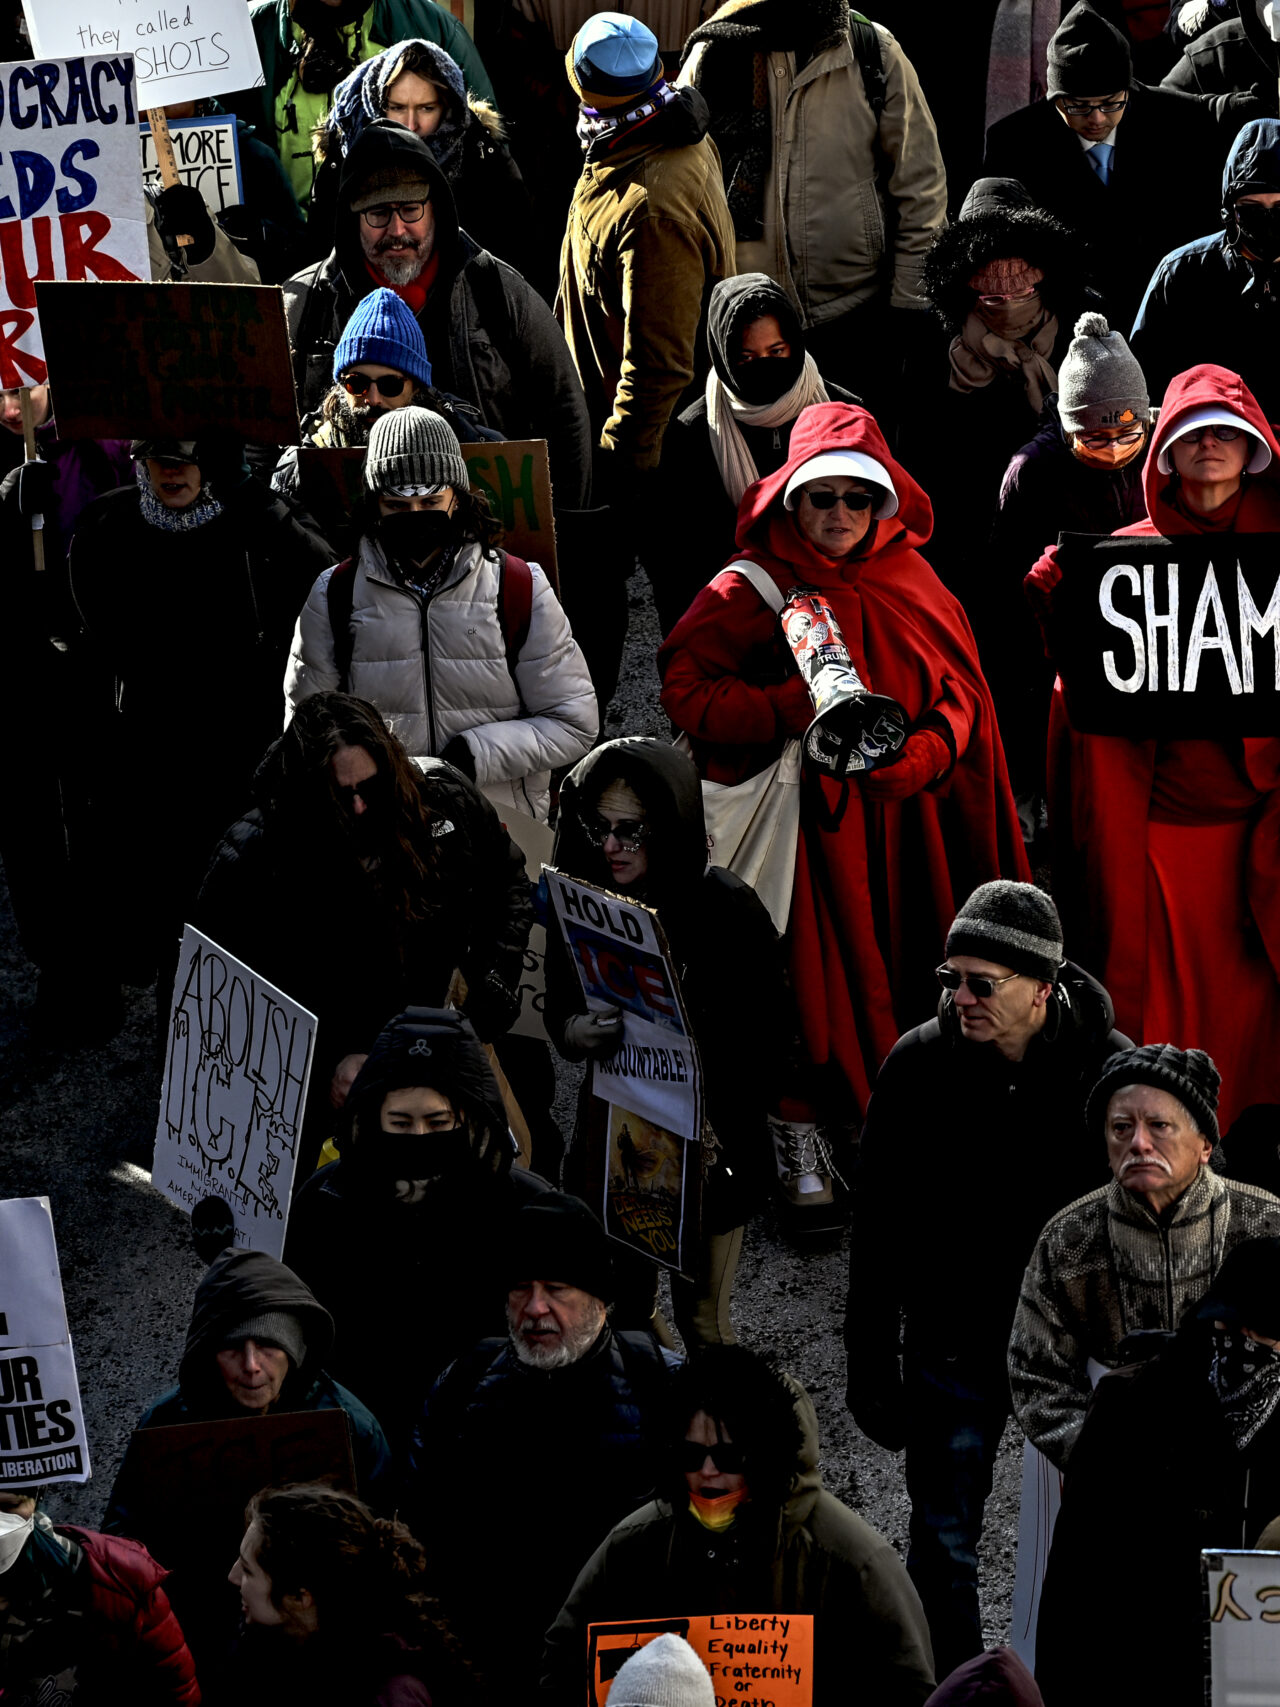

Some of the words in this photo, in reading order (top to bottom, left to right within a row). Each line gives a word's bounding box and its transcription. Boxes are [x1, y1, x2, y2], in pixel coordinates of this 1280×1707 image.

[77, 25, 120, 51] they
[136, 5, 194, 36] called
[135, 32, 230, 79] SHOTS
[559, 882, 643, 945] HOLD
[578, 941, 675, 1018] ICE
[175, 944, 312, 1122] ABOLISH
[621, 1210, 672, 1235] NEEDS
[639, 1229, 676, 1255] YOU
[710, 1616, 790, 1638] Liberty
[708, 1639, 788, 1662] Equality
[710, 1662, 801, 1684] Fraternity
[734, 1681, 752, 1692] or
